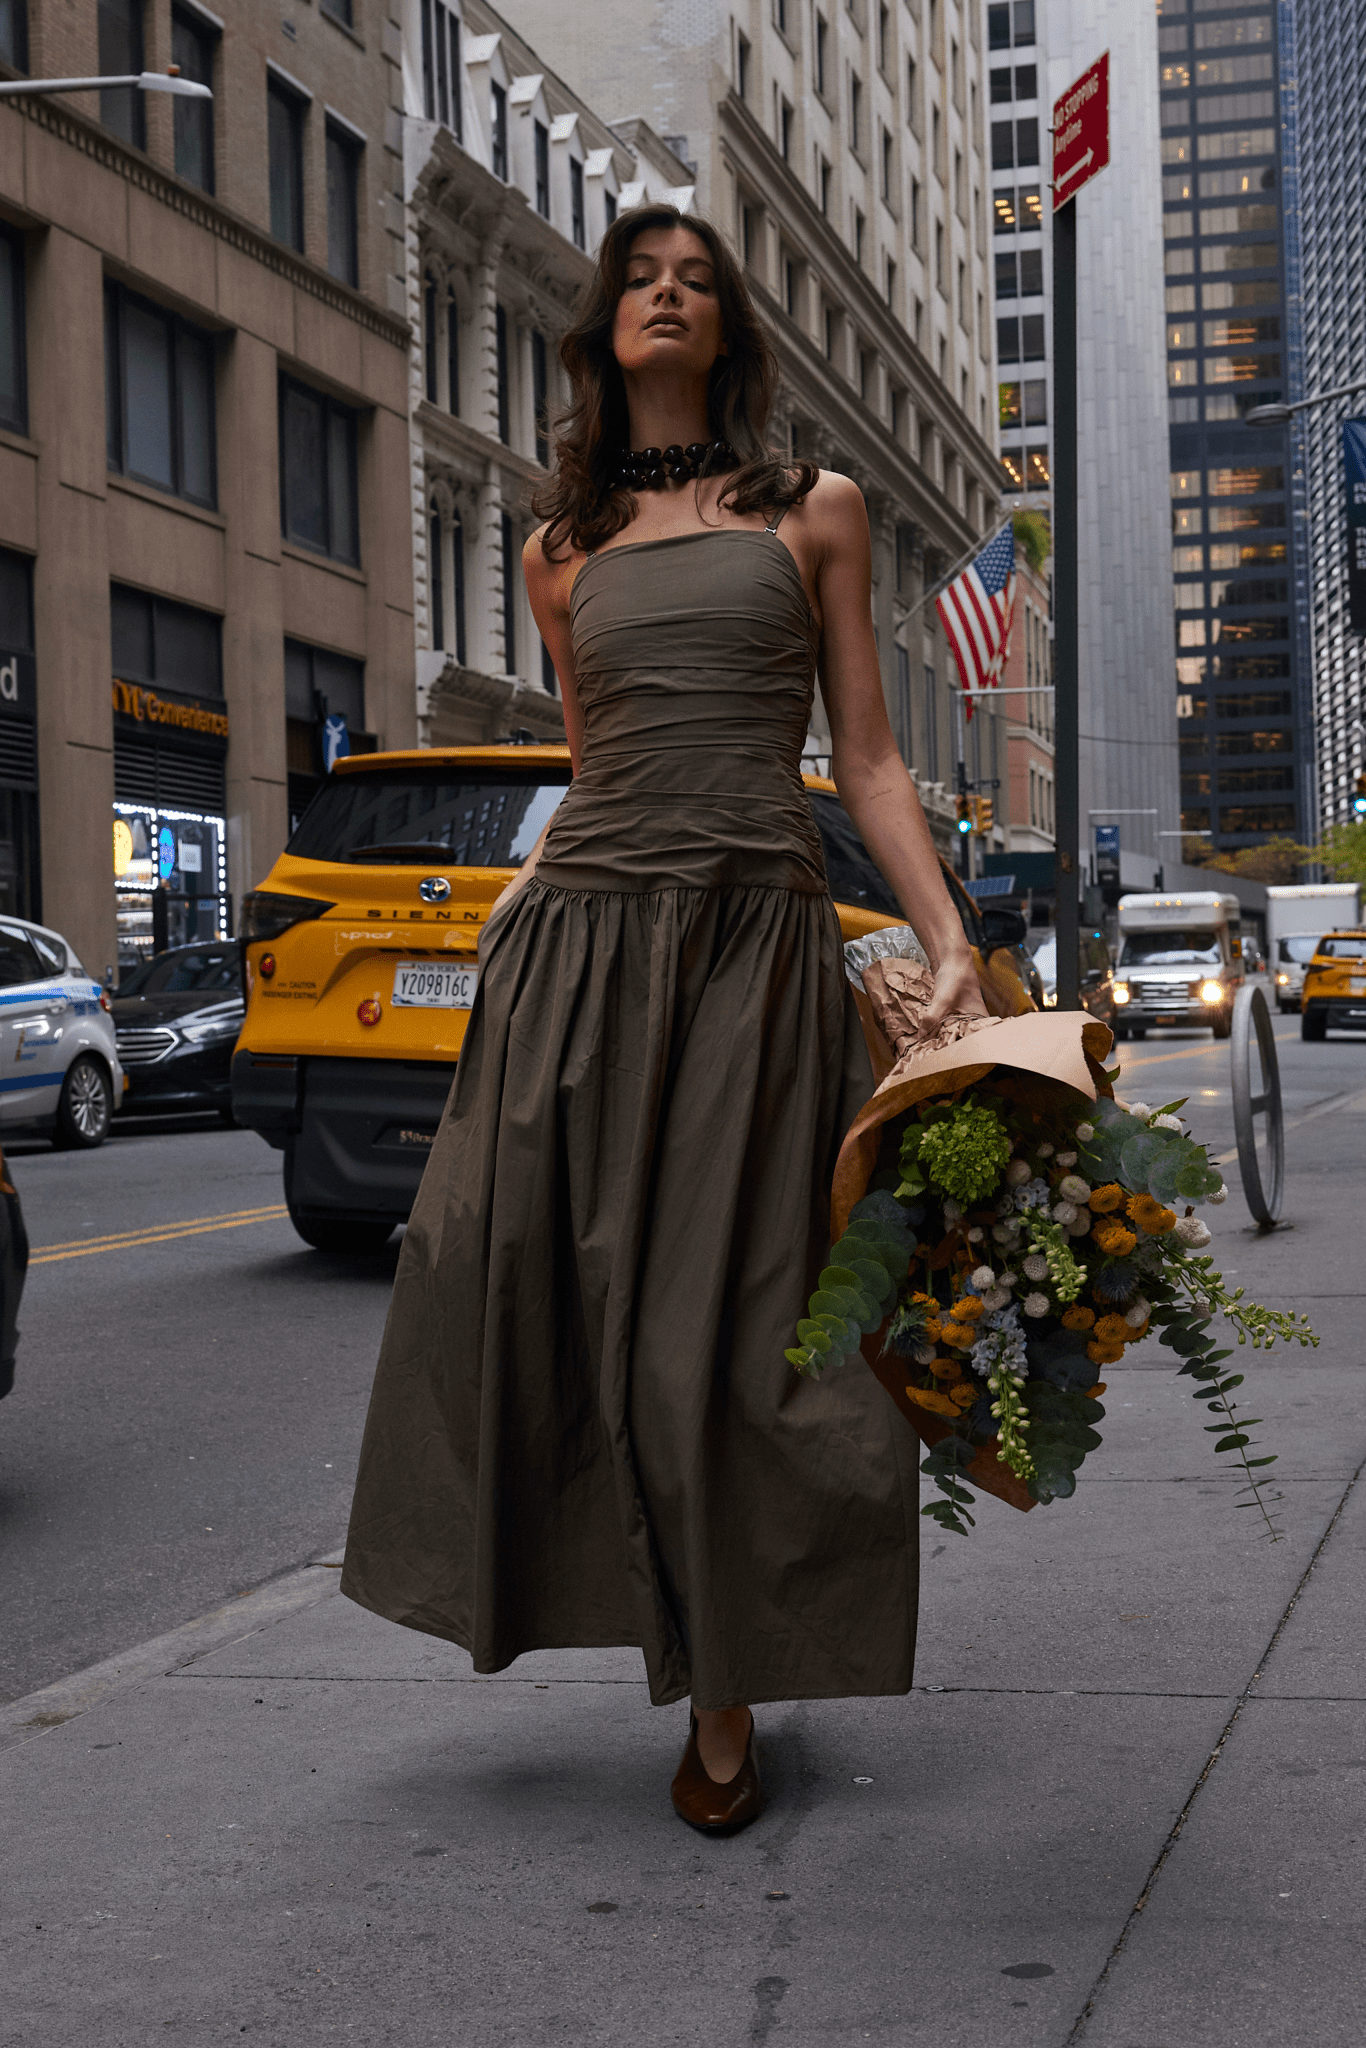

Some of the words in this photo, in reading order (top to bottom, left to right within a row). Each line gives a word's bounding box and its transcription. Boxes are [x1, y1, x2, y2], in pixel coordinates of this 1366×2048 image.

[1065, 72, 1099, 121] STOPPING
[1055, 118, 1082, 156] Anytime
[146, 692, 229, 737] Convenience
[367, 909, 479, 920] SIENN
[416, 964, 435, 972] NEW
[437, 965, 457, 973] YORK
[402, 973, 469, 996] Y209816C
